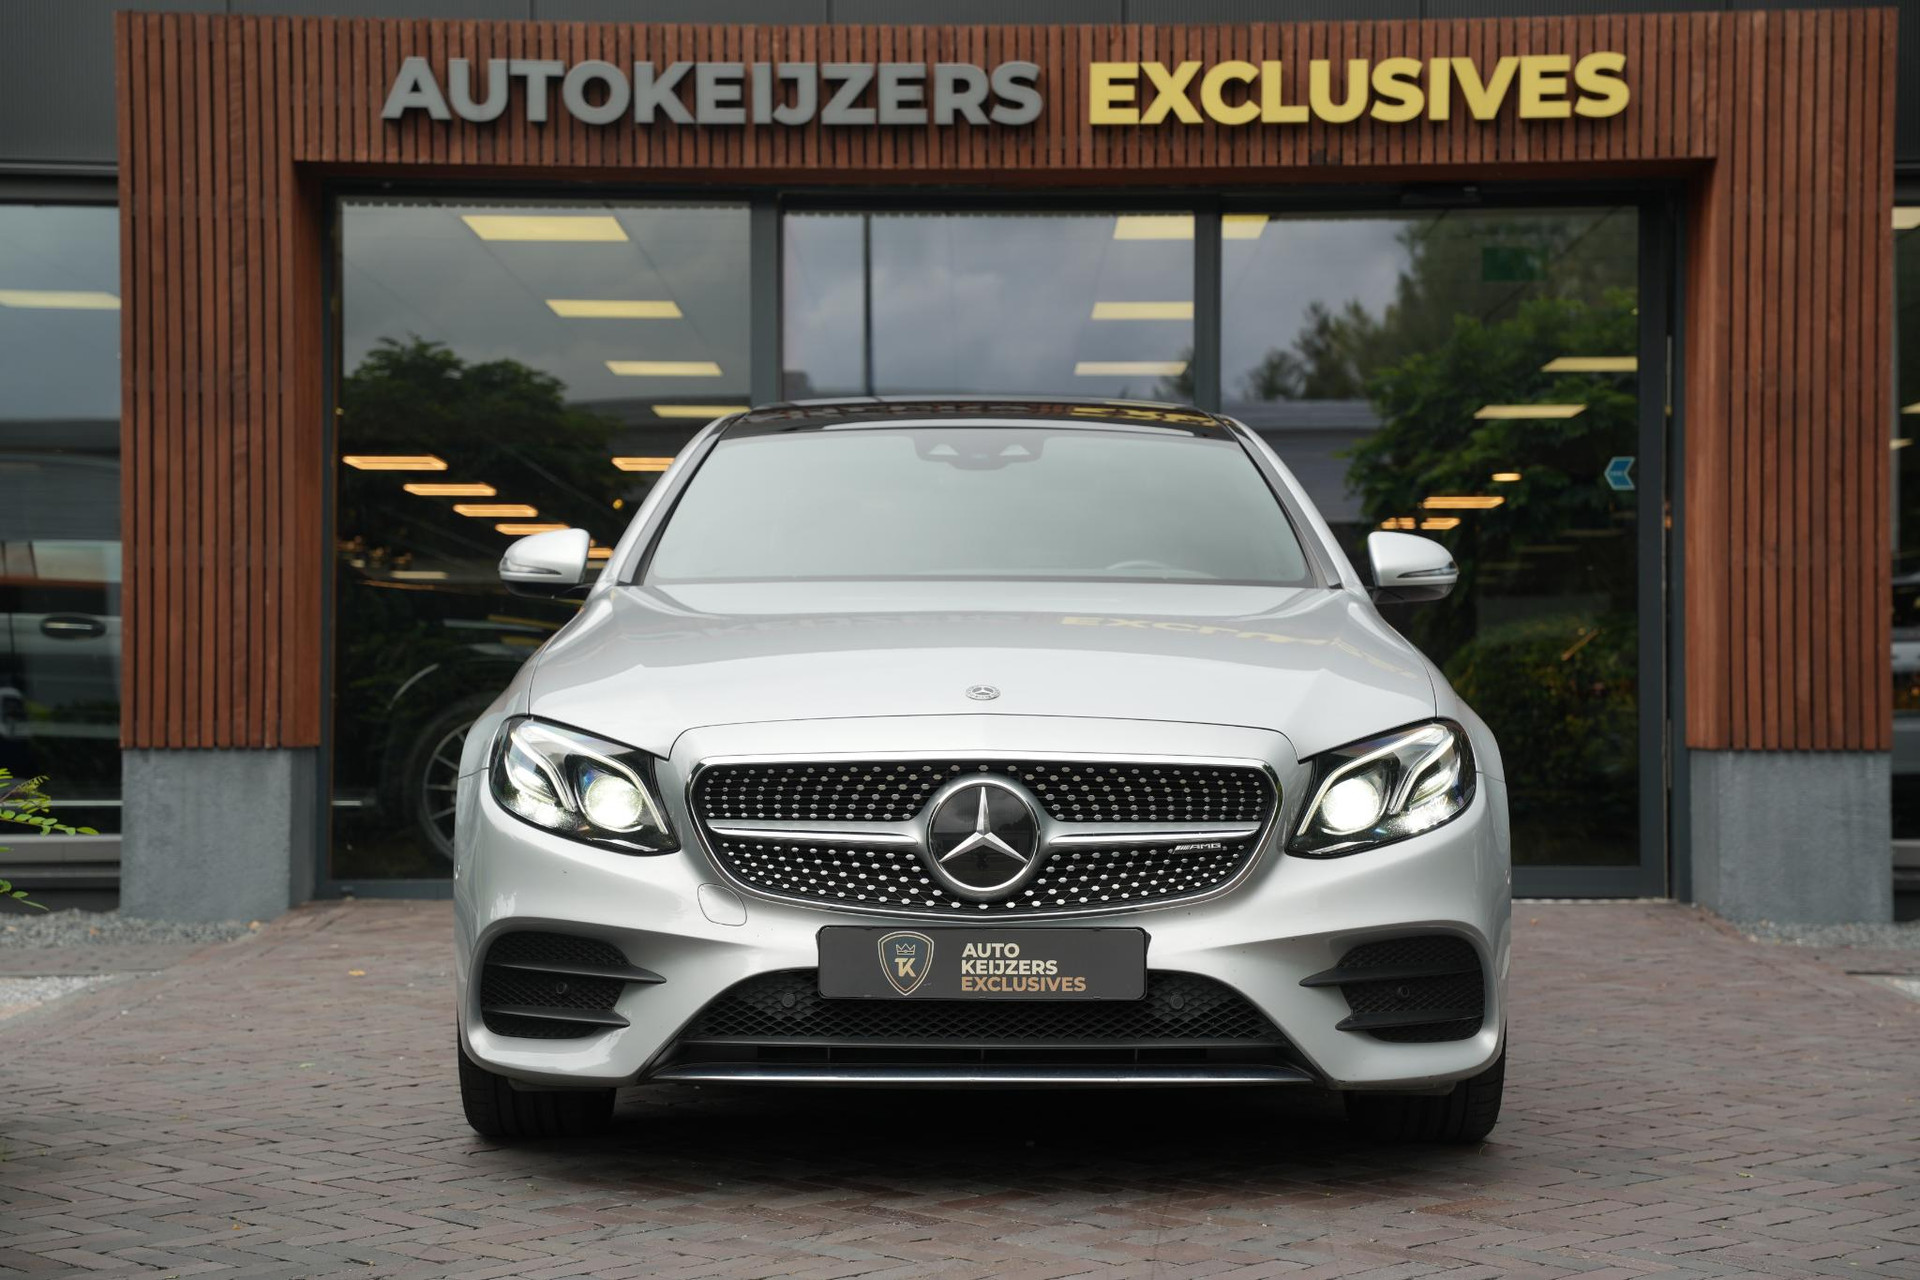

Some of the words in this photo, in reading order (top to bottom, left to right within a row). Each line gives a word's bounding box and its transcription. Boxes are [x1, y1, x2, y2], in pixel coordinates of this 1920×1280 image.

[381, 56, 1043, 126] AUTOKEIJZERS
[1089, 51, 1631, 126] EXCLUSIVES
[961, 942, 1020, 959] AUTO
[961, 959, 1058, 976] KEIJZERS
[961, 976, 1087, 992] EXCLUSIVES
